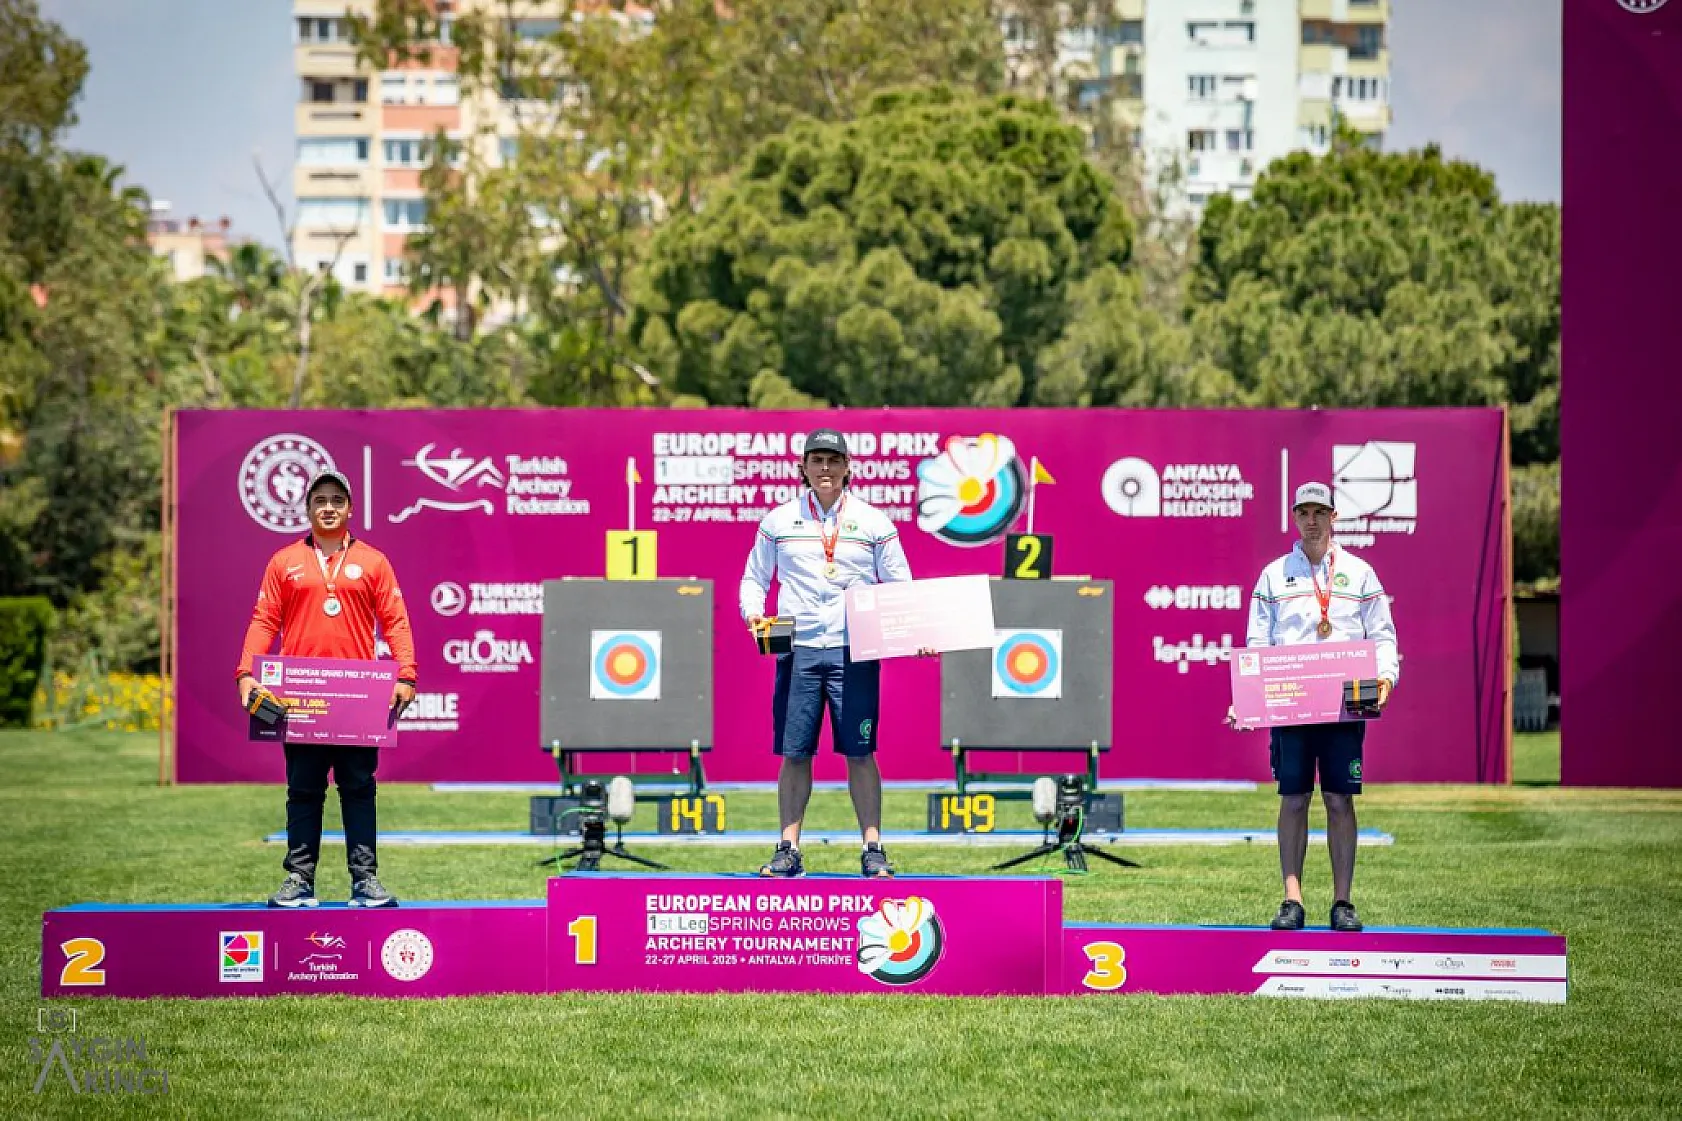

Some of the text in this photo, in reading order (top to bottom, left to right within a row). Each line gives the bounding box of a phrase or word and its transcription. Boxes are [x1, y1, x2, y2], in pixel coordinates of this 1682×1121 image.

[653, 432, 787, 455] EUROPEAN
[790, 432, 876, 455] GND
[881, 432, 940, 455] PRIX
[506, 454, 567, 474] Turkish
[734, 460, 801, 480] SPRIN
[851, 460, 910, 480] ROWS
[1163, 464, 1241, 481] ANTALYA
[505, 477, 572, 497] Archery
[652, 485, 758, 504] ARCHERY
[621, 536, 638, 575] 1
[1014, 535, 1042, 578] 2
[671, 793, 725, 831] 147
[941, 794, 995, 832] 149
[646, 894, 875, 912] EUROPEAN GRAND PRIX
[650, 915, 851, 934] 1st Leg SPRING ARROWS
[567, 914, 597, 965] 1
[645, 937, 854, 951] ARCHERY TOURNAMENT
[60, 937, 106, 987] 2
[308, 962, 338, 972] Turkish
[645, 954, 675, 965] 22-27
[677, 954, 710, 965] APRIL
[712, 954, 738, 965] 2025
[748, 954, 796, 965] ANTALYA
[805, 952, 852, 965] TÜRKİYE
[1082, 940, 1127, 991] 3
[288, 971, 358, 983] Archery Federation
